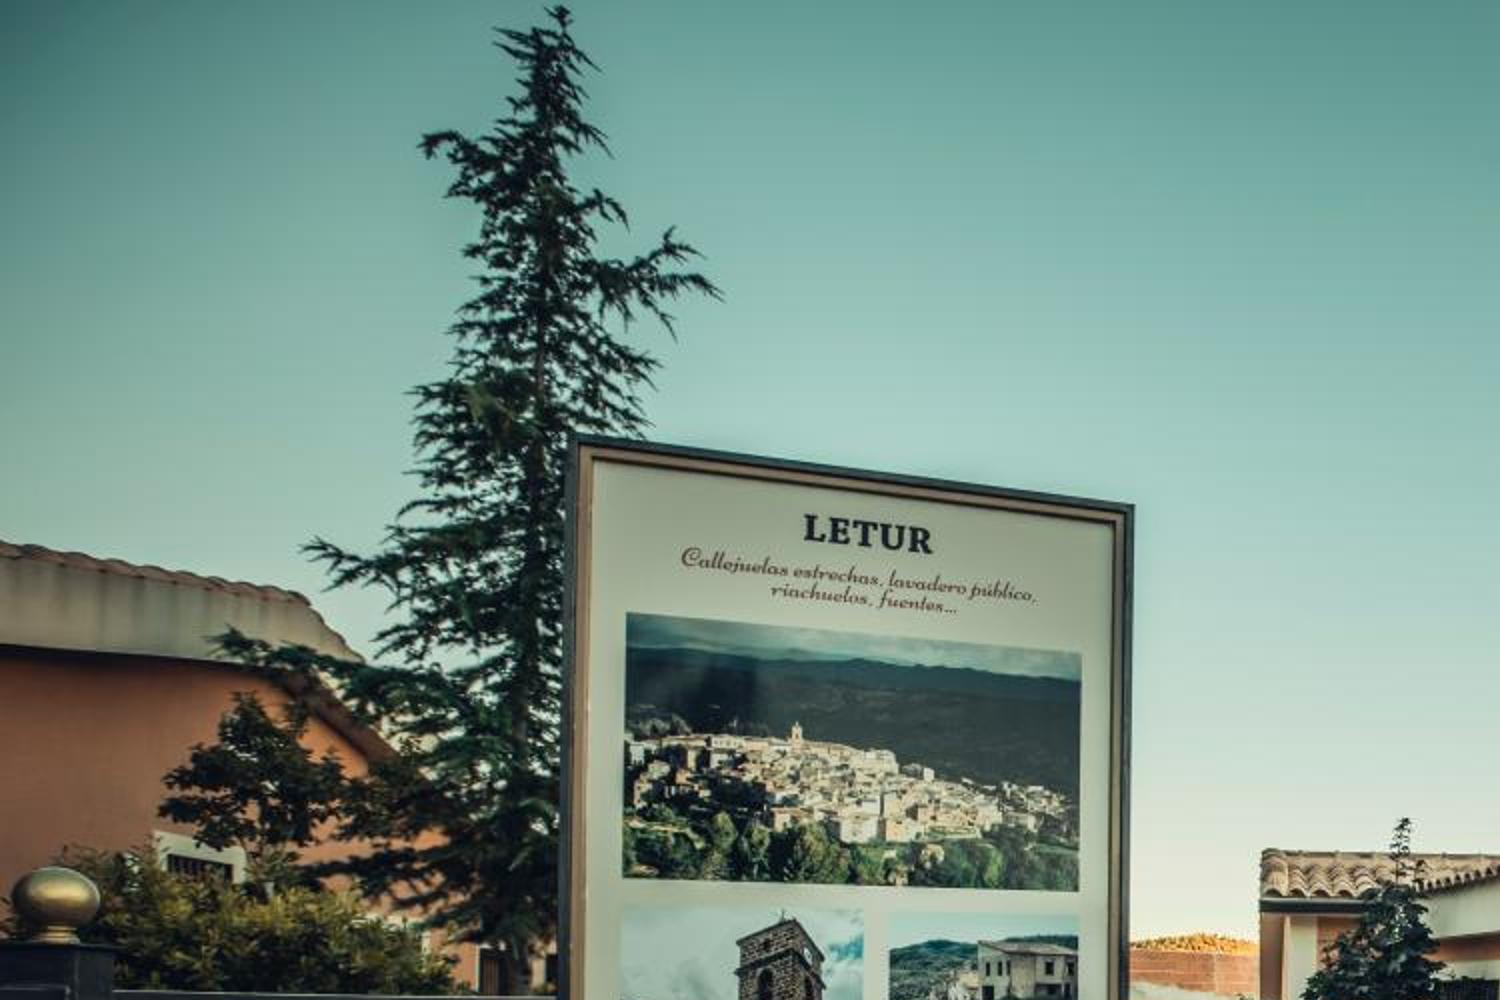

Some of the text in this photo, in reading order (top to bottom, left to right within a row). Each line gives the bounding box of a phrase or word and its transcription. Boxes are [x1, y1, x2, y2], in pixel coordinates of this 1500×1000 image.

[803, 513, 933, 554] LETUR
[680, 546, 789, 578] Callejuelas
[887, 569, 967, 596] lavadero
[969, 578, 1040, 604] público,
[769, 582, 958, 615] riachuelos, fuentes...
